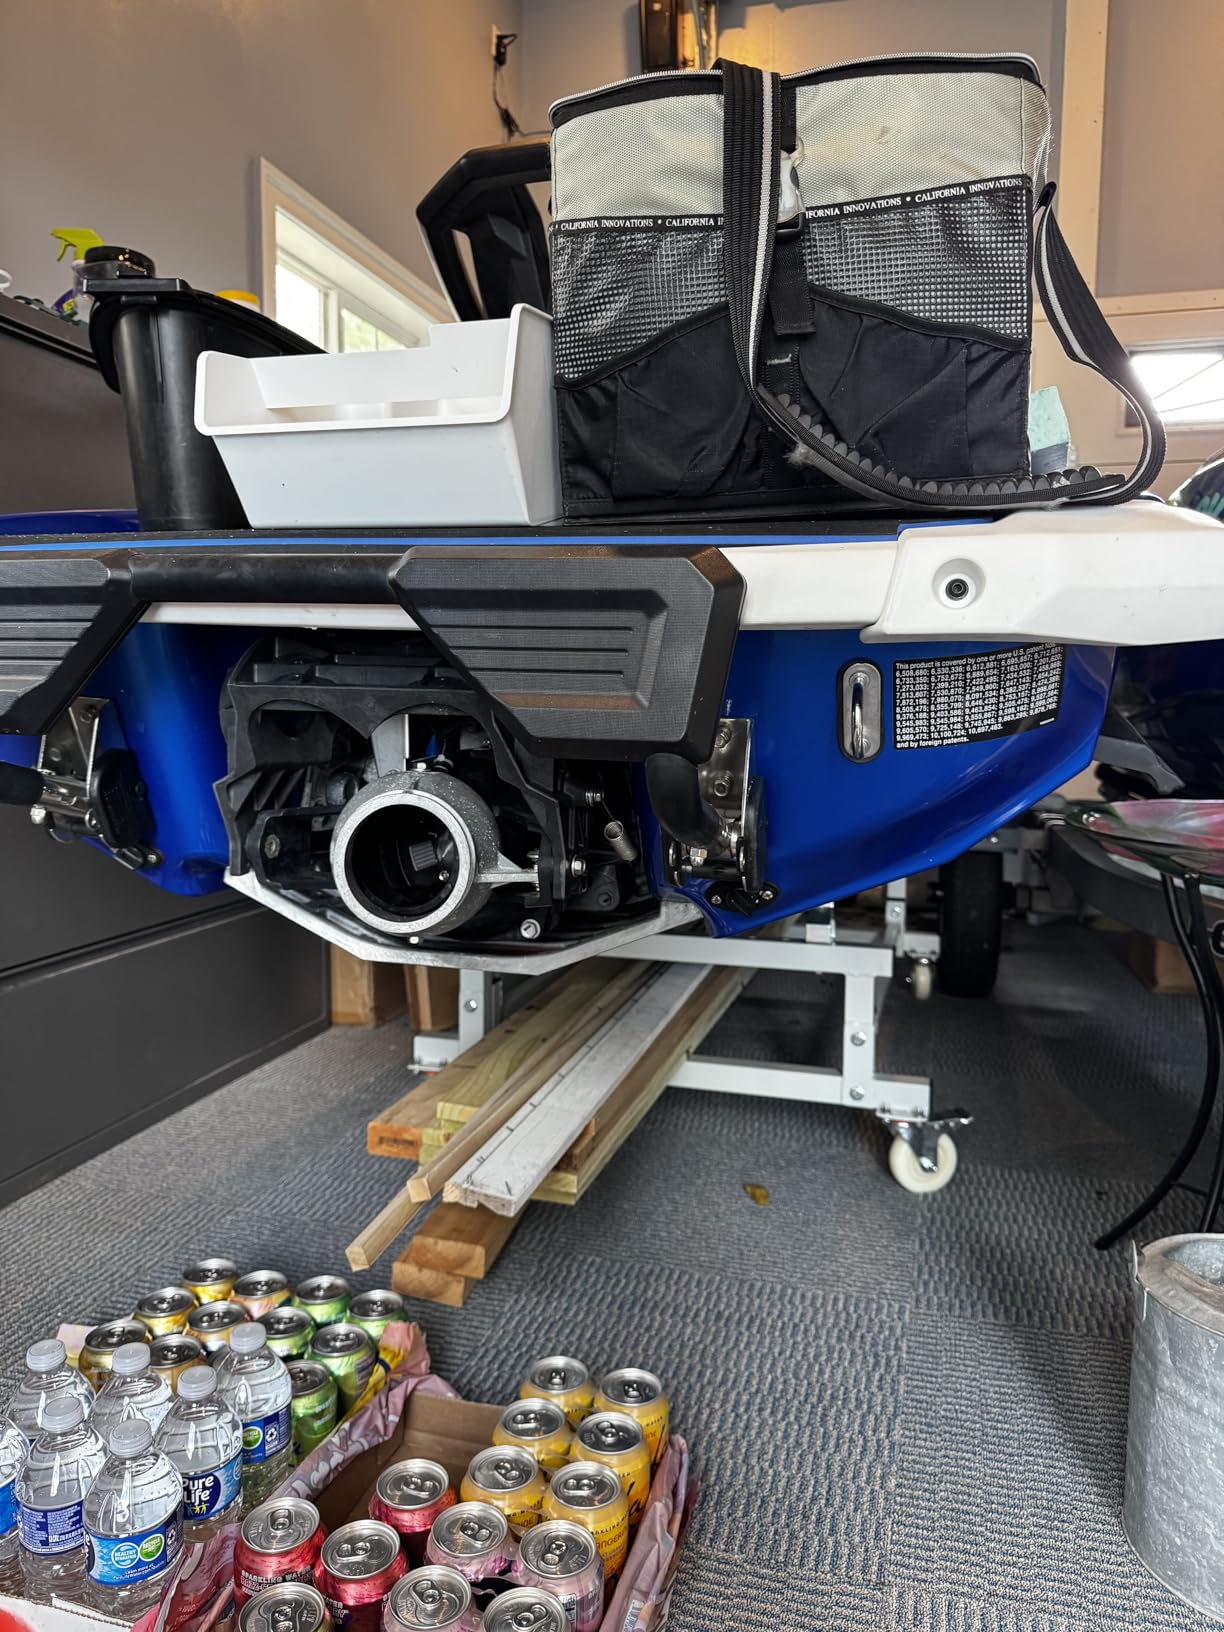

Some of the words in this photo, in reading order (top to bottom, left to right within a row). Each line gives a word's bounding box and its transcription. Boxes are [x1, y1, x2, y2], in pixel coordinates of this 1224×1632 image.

[914, 186, 966, 203] CALIFORNIA
[968, 177, 1022, 193] INNOVATIONS
[843, 197, 902, 214] INNOVATIONS
[560, 220, 599, 231] CALIFORNIA
[601, 219, 654, 228] INNOVATIONS
[666, 218, 714, 228] CALIFORNIA
[896, 662, 909, 670] This
[910, 660, 934, 670] product
[935, 660, 940, 668] is
[942, 657, 966, 667] covered
[968, 657, 976, 665] by
[996, 652, 1012, 660] more
[1013, 648, 1025, 657] U.S.
[896, 683, 929, 691] 7,273,033;
[910, 740, 918, 748] by
[920, 738, 942, 748] foreign
[943, 736, 970, 746] patents.
[183, 1476, 214, 1490] Pure
[184, 1489, 210, 1506] Life
[242, 1570, 282, 1584] SPARKLING
[286, 1566, 311, 1581] WATER
